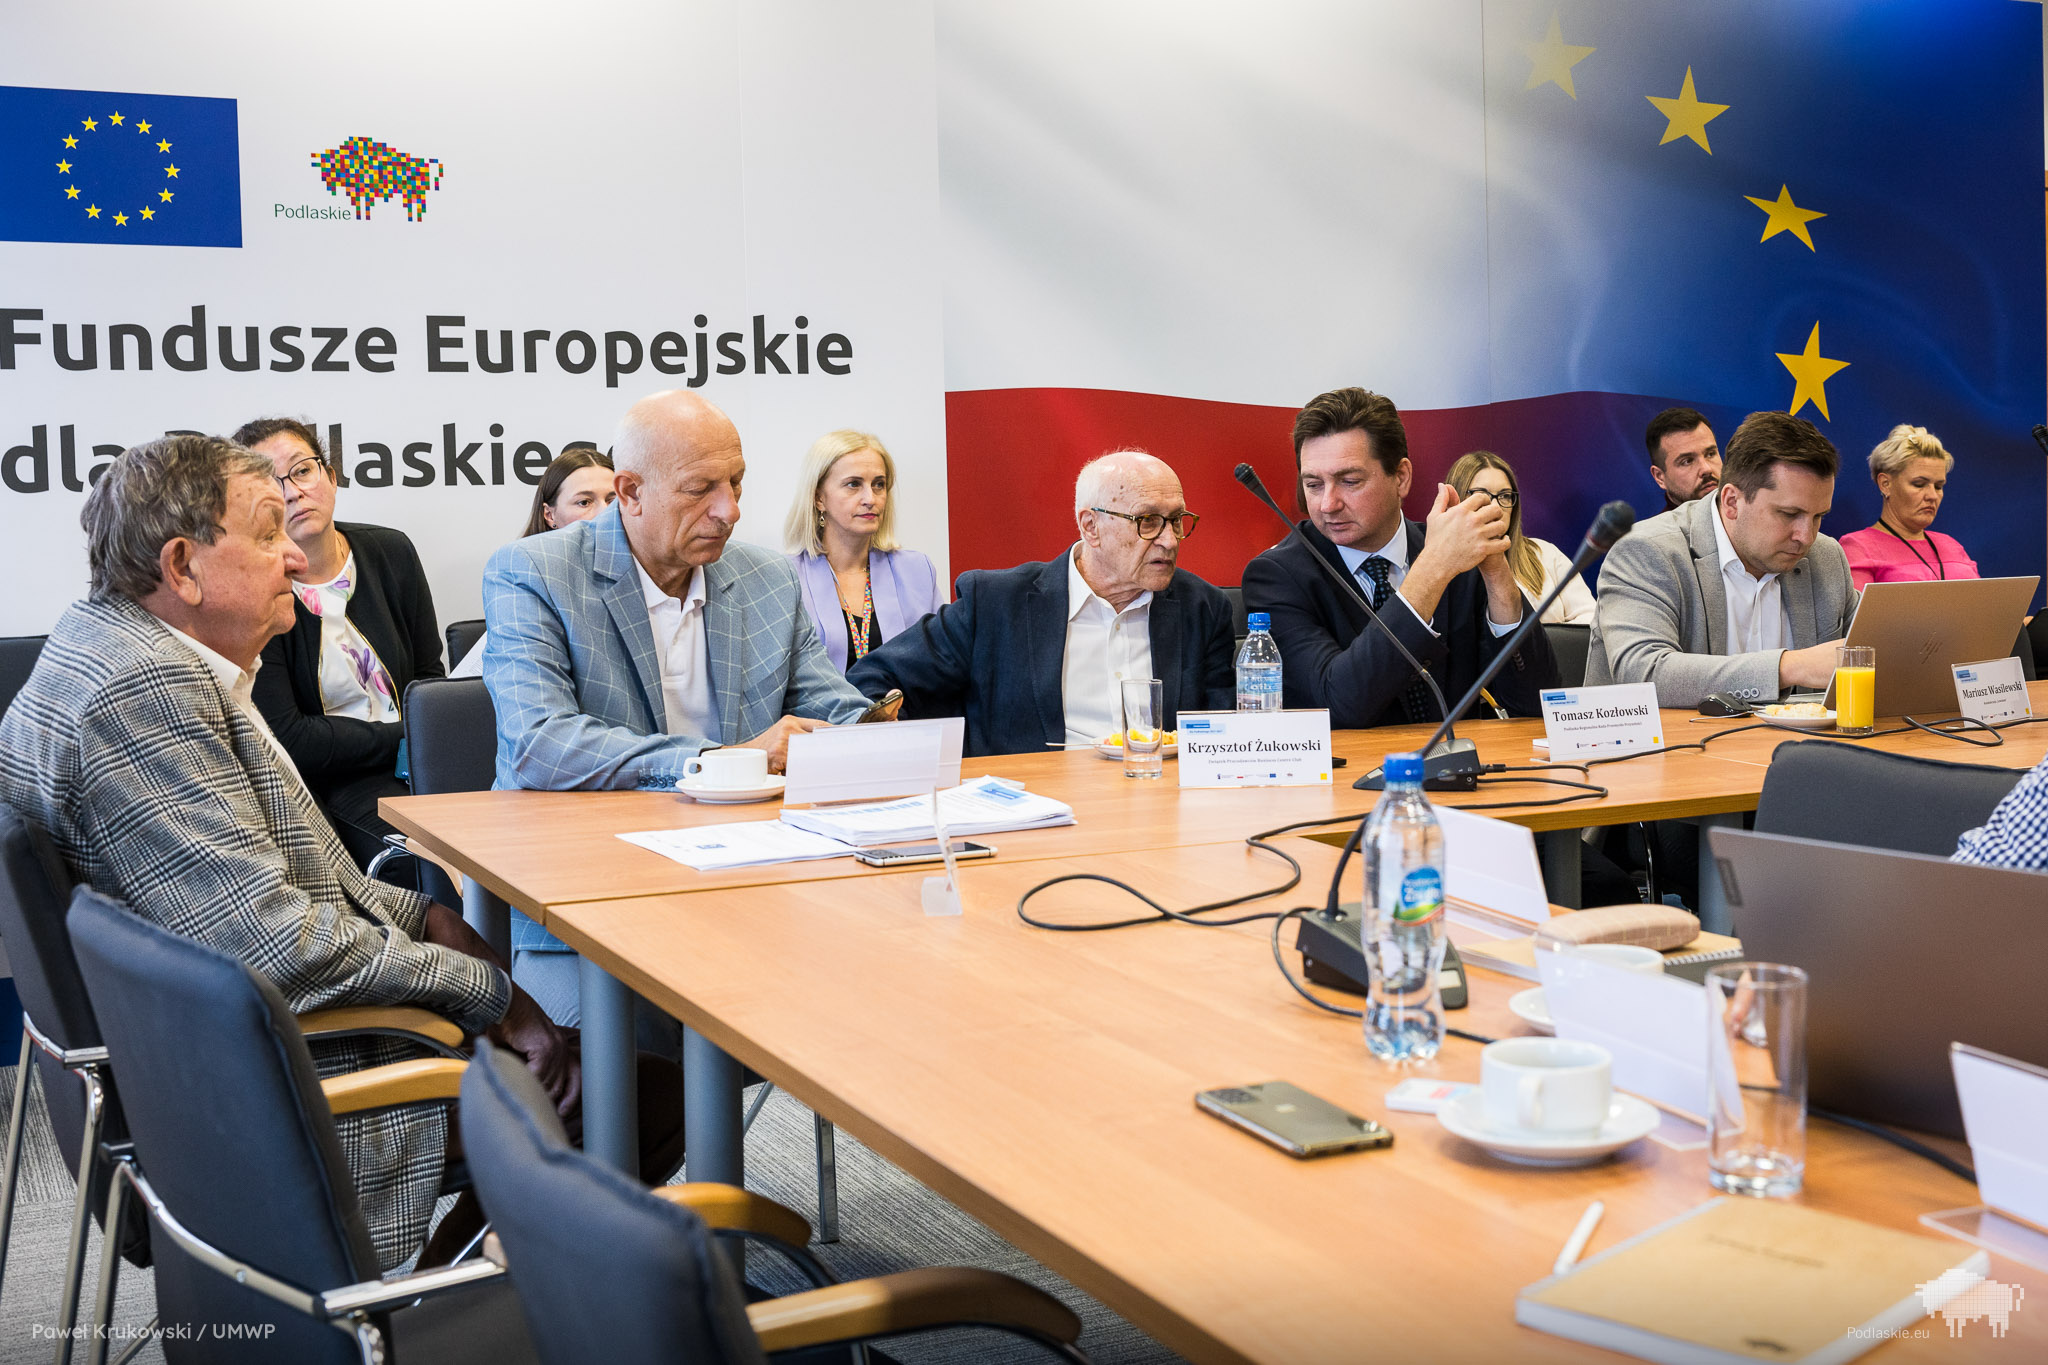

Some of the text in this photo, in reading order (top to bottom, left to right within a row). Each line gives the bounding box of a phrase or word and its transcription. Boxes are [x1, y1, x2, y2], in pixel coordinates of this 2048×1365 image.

[274, 203, 352, 221] Podlaskie
[0, 304, 854, 388] Fundusze Europejskie
[164, 422, 613, 489] laskie
[1962, 681, 2023, 699] Mariusz Wasilewski
[1552, 705, 1649, 722] Tomasz Kozłowski
[1188, 738, 1321, 756] Krzysztof Żukowski
